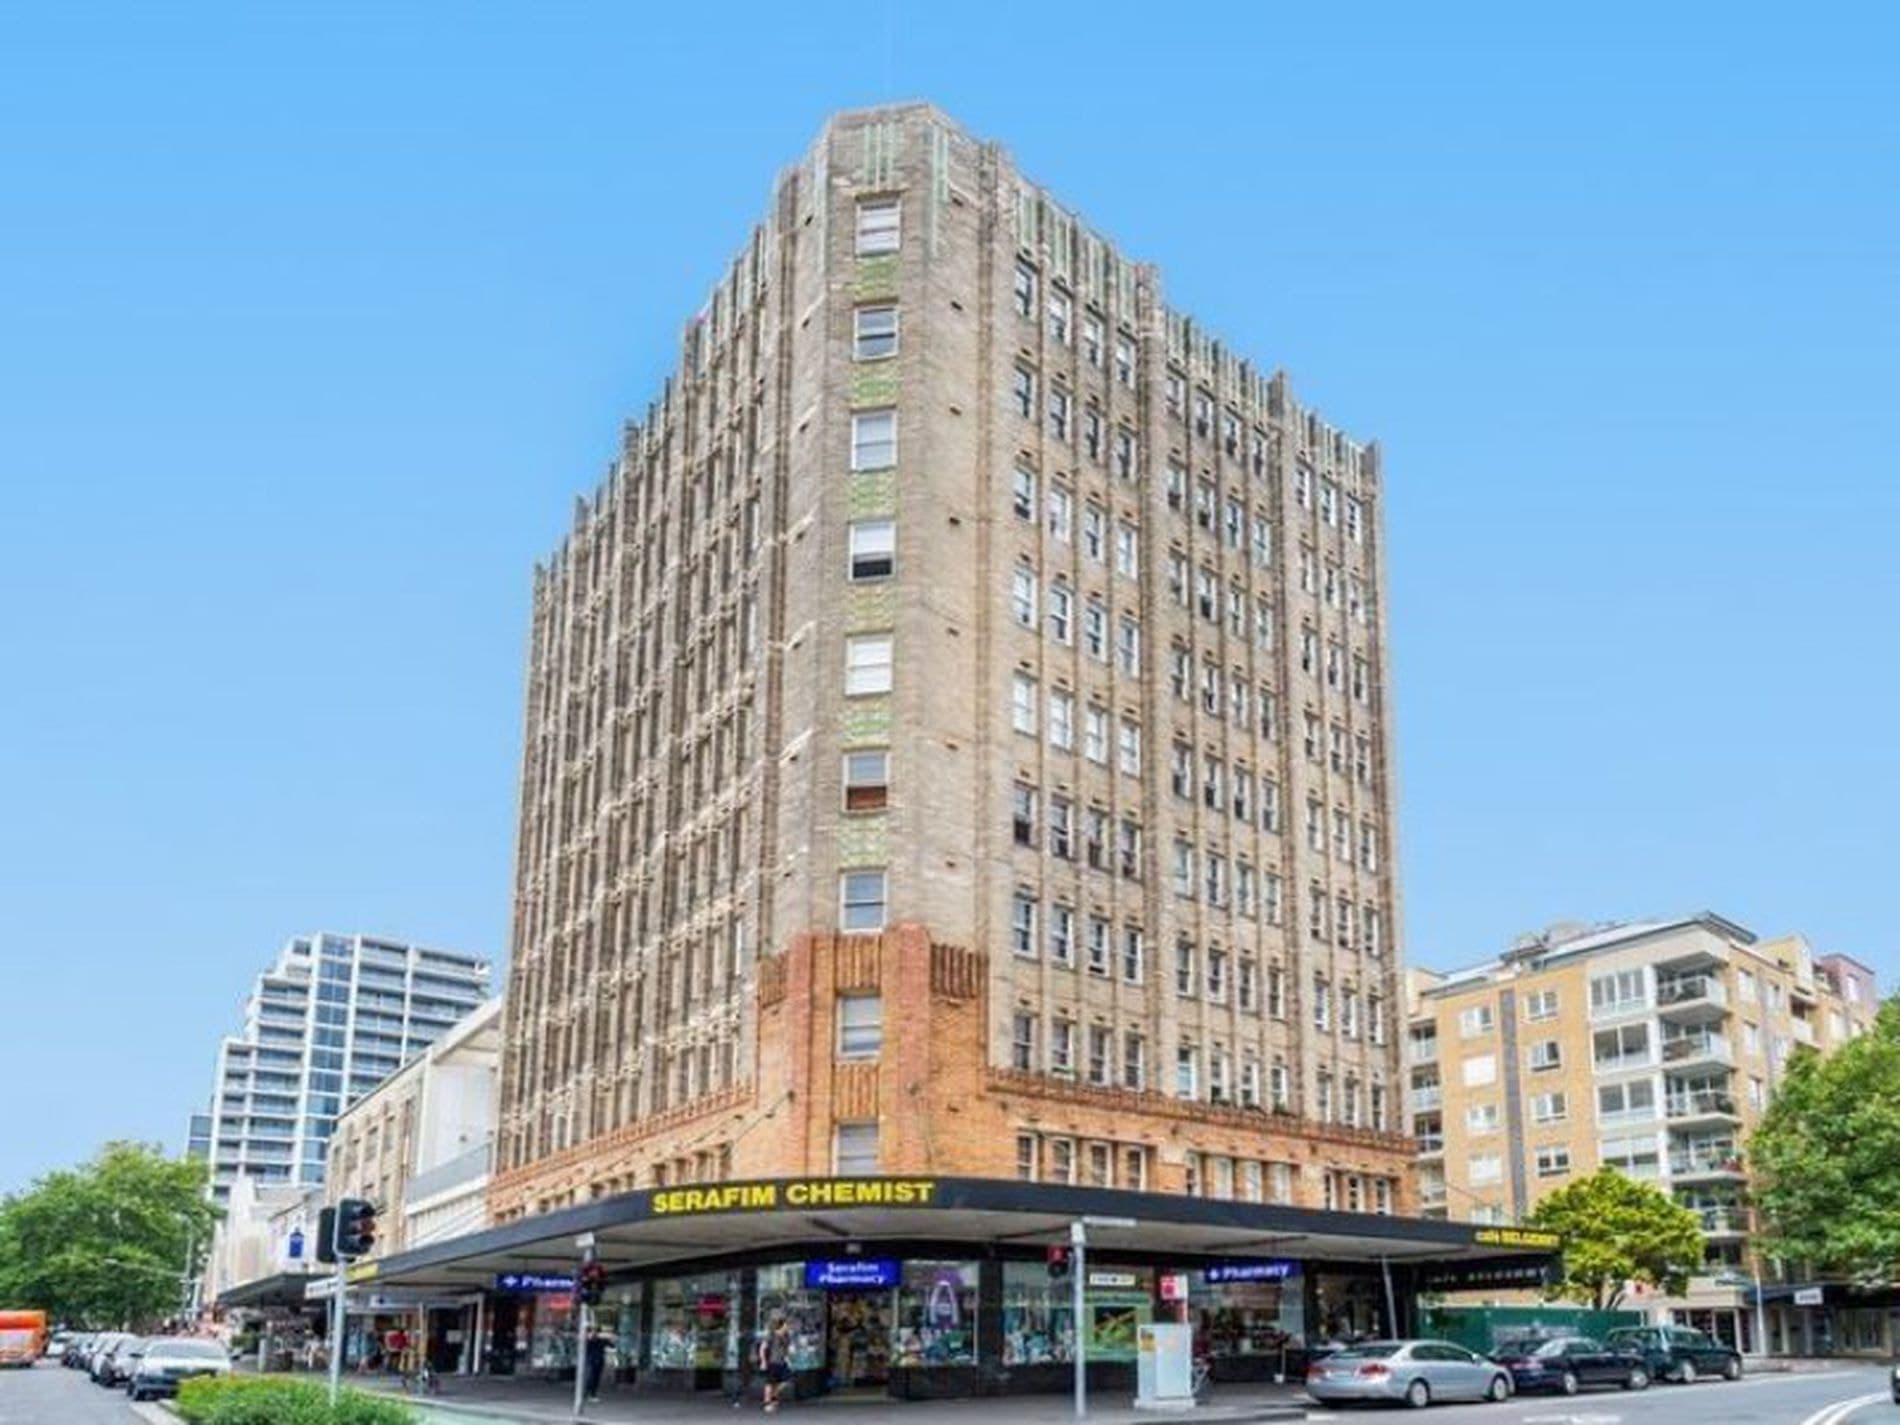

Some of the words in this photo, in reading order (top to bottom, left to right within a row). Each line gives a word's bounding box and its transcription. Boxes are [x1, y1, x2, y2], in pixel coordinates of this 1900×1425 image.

[653, 1184, 776, 1213] SERAFIM
[785, 1181, 934, 1205] CHEMIST
[827, 1262, 879, 1274] Serafim
[1222, 1263, 1289, 1280] Pharmacy
[521, 1275, 574, 1288] Pharm
[818, 1273, 885, 1286] Pharmacy
